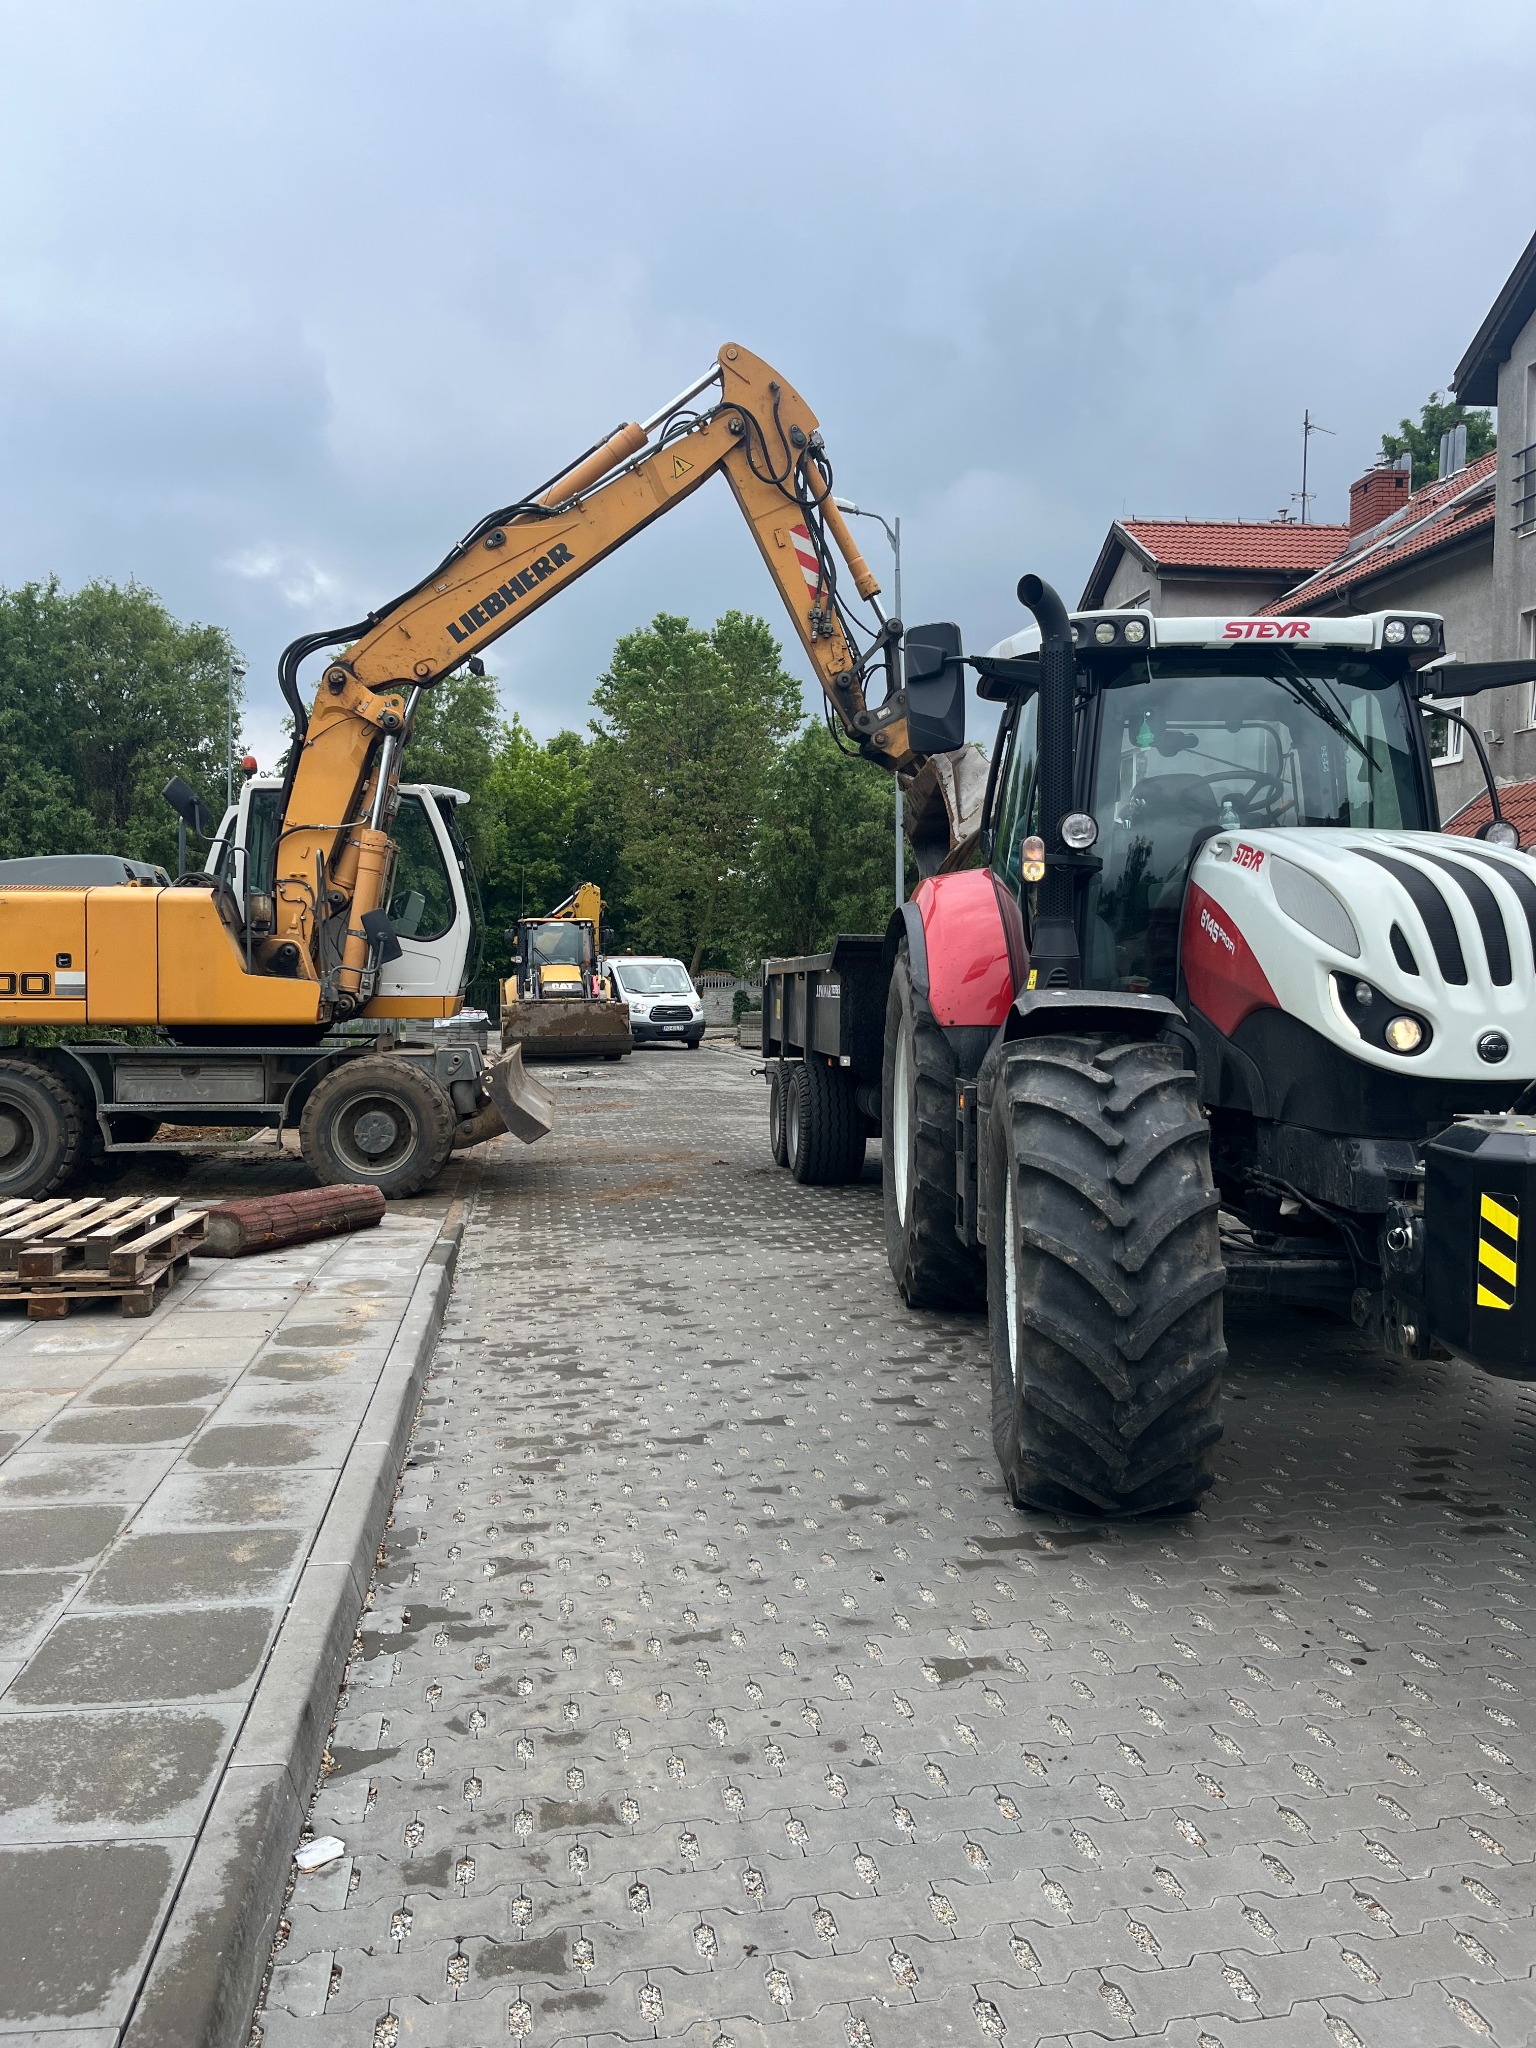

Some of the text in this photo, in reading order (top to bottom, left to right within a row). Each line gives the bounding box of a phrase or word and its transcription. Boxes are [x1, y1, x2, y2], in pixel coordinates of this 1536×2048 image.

[446, 543, 576, 644] LIEBHERR
[1222, 622, 1311, 638] STEYR
[1232, 843, 1265, 872] STEYR
